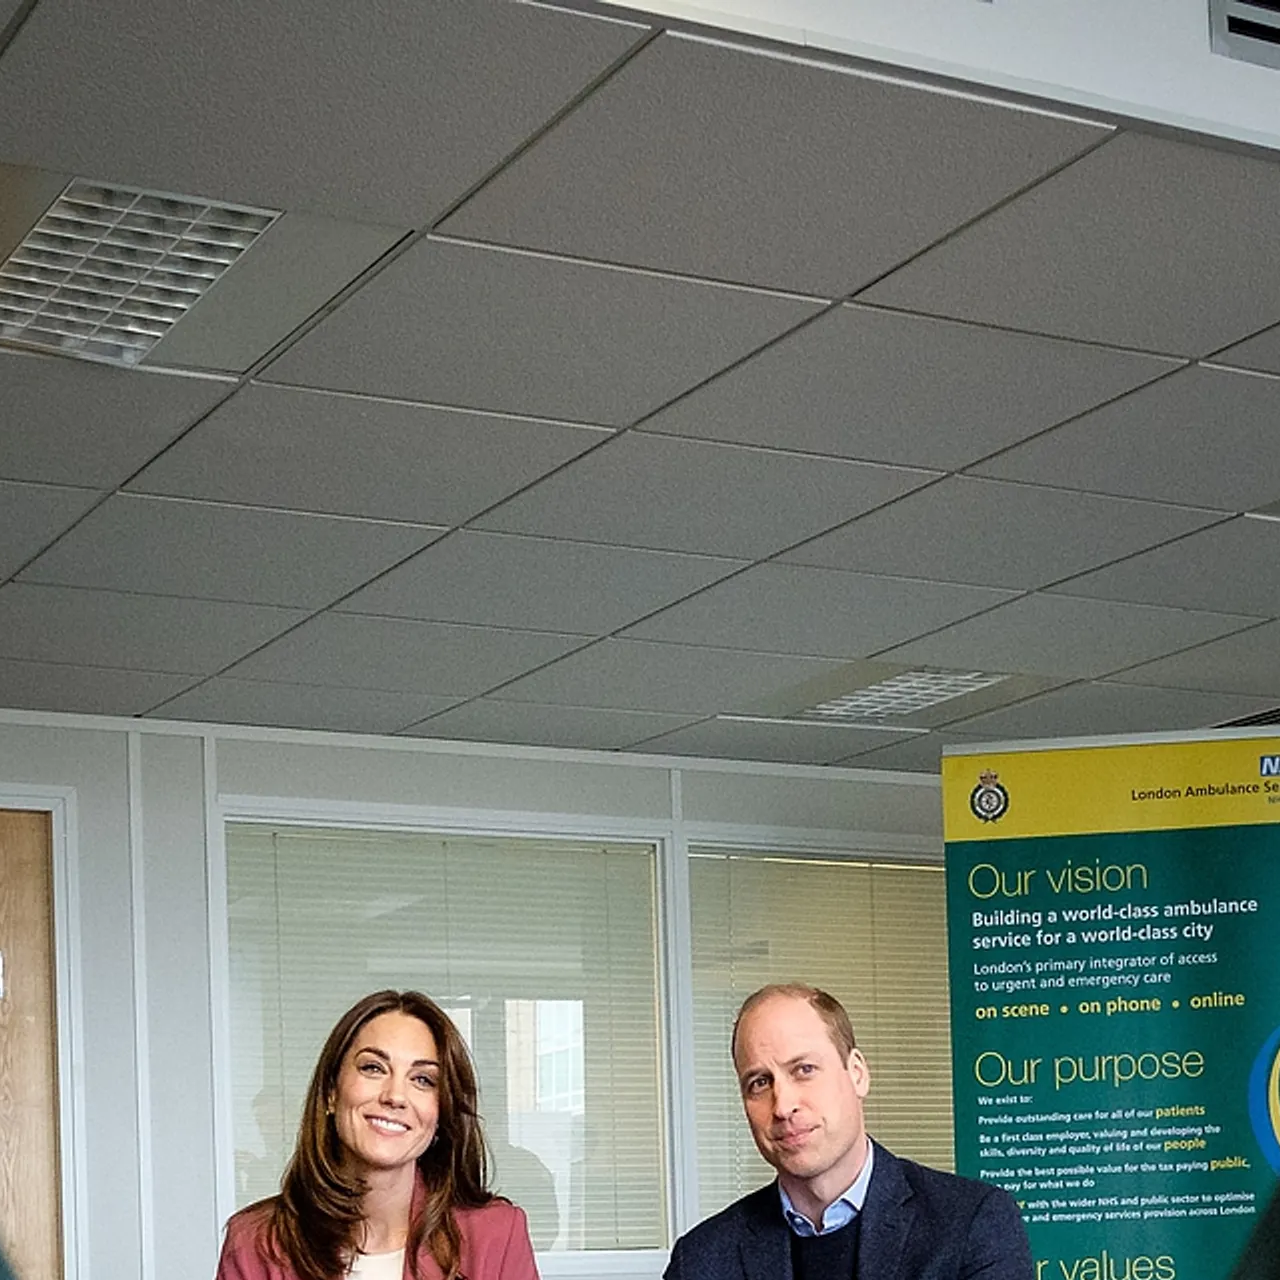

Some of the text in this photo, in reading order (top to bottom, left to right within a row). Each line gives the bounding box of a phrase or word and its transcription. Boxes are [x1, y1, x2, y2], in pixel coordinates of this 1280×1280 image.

[1131, 787, 1181, 801] London
[1184, 782, 1260, 797] Ambulance
[968, 858, 1148, 899] Our vision
[972, 898, 1258, 928] Building a world-class ambulance
[972, 922, 1214, 949] service for a world-class city
[973, 952, 1218, 975] London's primary integrator of access
[974, 971, 1171, 993] to urgent and emergency care
[975, 992, 1246, 1020] on scene on phone online
[975, 1050, 1205, 1091] Our purpose
[978, 1096, 993, 1105] We
[995, 1094, 1018, 1105] exist
[978, 1104, 1206, 1125] Provide outstanding care for all of our patients
[979, 1134, 991, 1143] Be
[993, 1135, 1000, 1143] a
[1001, 1132, 1020, 1143] first
[1022, 1132, 1044, 1141] class
[1092, 1128, 1128, 1139] valuing
[1130, 1128, 1148, 1137] and
[1150, 1126, 1203, 1136] developing
[1204, 1124, 1221, 1134] the
[1006, 1146, 1047, 1157] diversity
[1048, 1145, 1067, 1154] and
[1068, 1144, 1101, 1155] quality
[1103, 1142, 1114, 1152] of
[1115, 1142, 1131, 1152] life
[1132, 1142, 1143, 1151] of
[1163, 1138, 1206, 1152] people
[980, 1168, 1015, 1179] Provide
[1017, 1167, 1033, 1177] the
[1034, 1166, 1055, 1176] best
[1056, 1165, 1095, 1177] possible
[1096, 1164, 1122, 1174] value
[1124, 1162, 1139, 1172] for
[1140, 1162, 1157, 1171] the
[1158, 1162, 1174, 1171] tax
[1176, 1161, 1209, 1172] paying
[1023, 1180, 1037, 1190] for
[1038, 1180, 1064, 1189] what
[1065, 1180, 1081, 1188] we
[1082, 1178, 1095, 1187] do
[1027, 1199, 1050, 1209] with
[1051, 1199, 1067, 1208] the
[1068, 1198, 1096, 1208] wider
[1120, 1196, 1139, 1205] and
[1140, 1194, 1169, 1207] public
[1170, 1194, 1200, 1204] sector
[1201, 1193, 1213, 1202] to
[1214, 1191, 1255, 1204] optimise
[1032, 1212, 1050, 1222] and
[1051, 1212, 1103, 1223] emergency
[1104, 1210, 1141, 1220] services
[1143, 1208, 1187, 1220] provision
[1188, 1207, 1218, 1216] across
[1219, 1205, 1256, 1215] London
